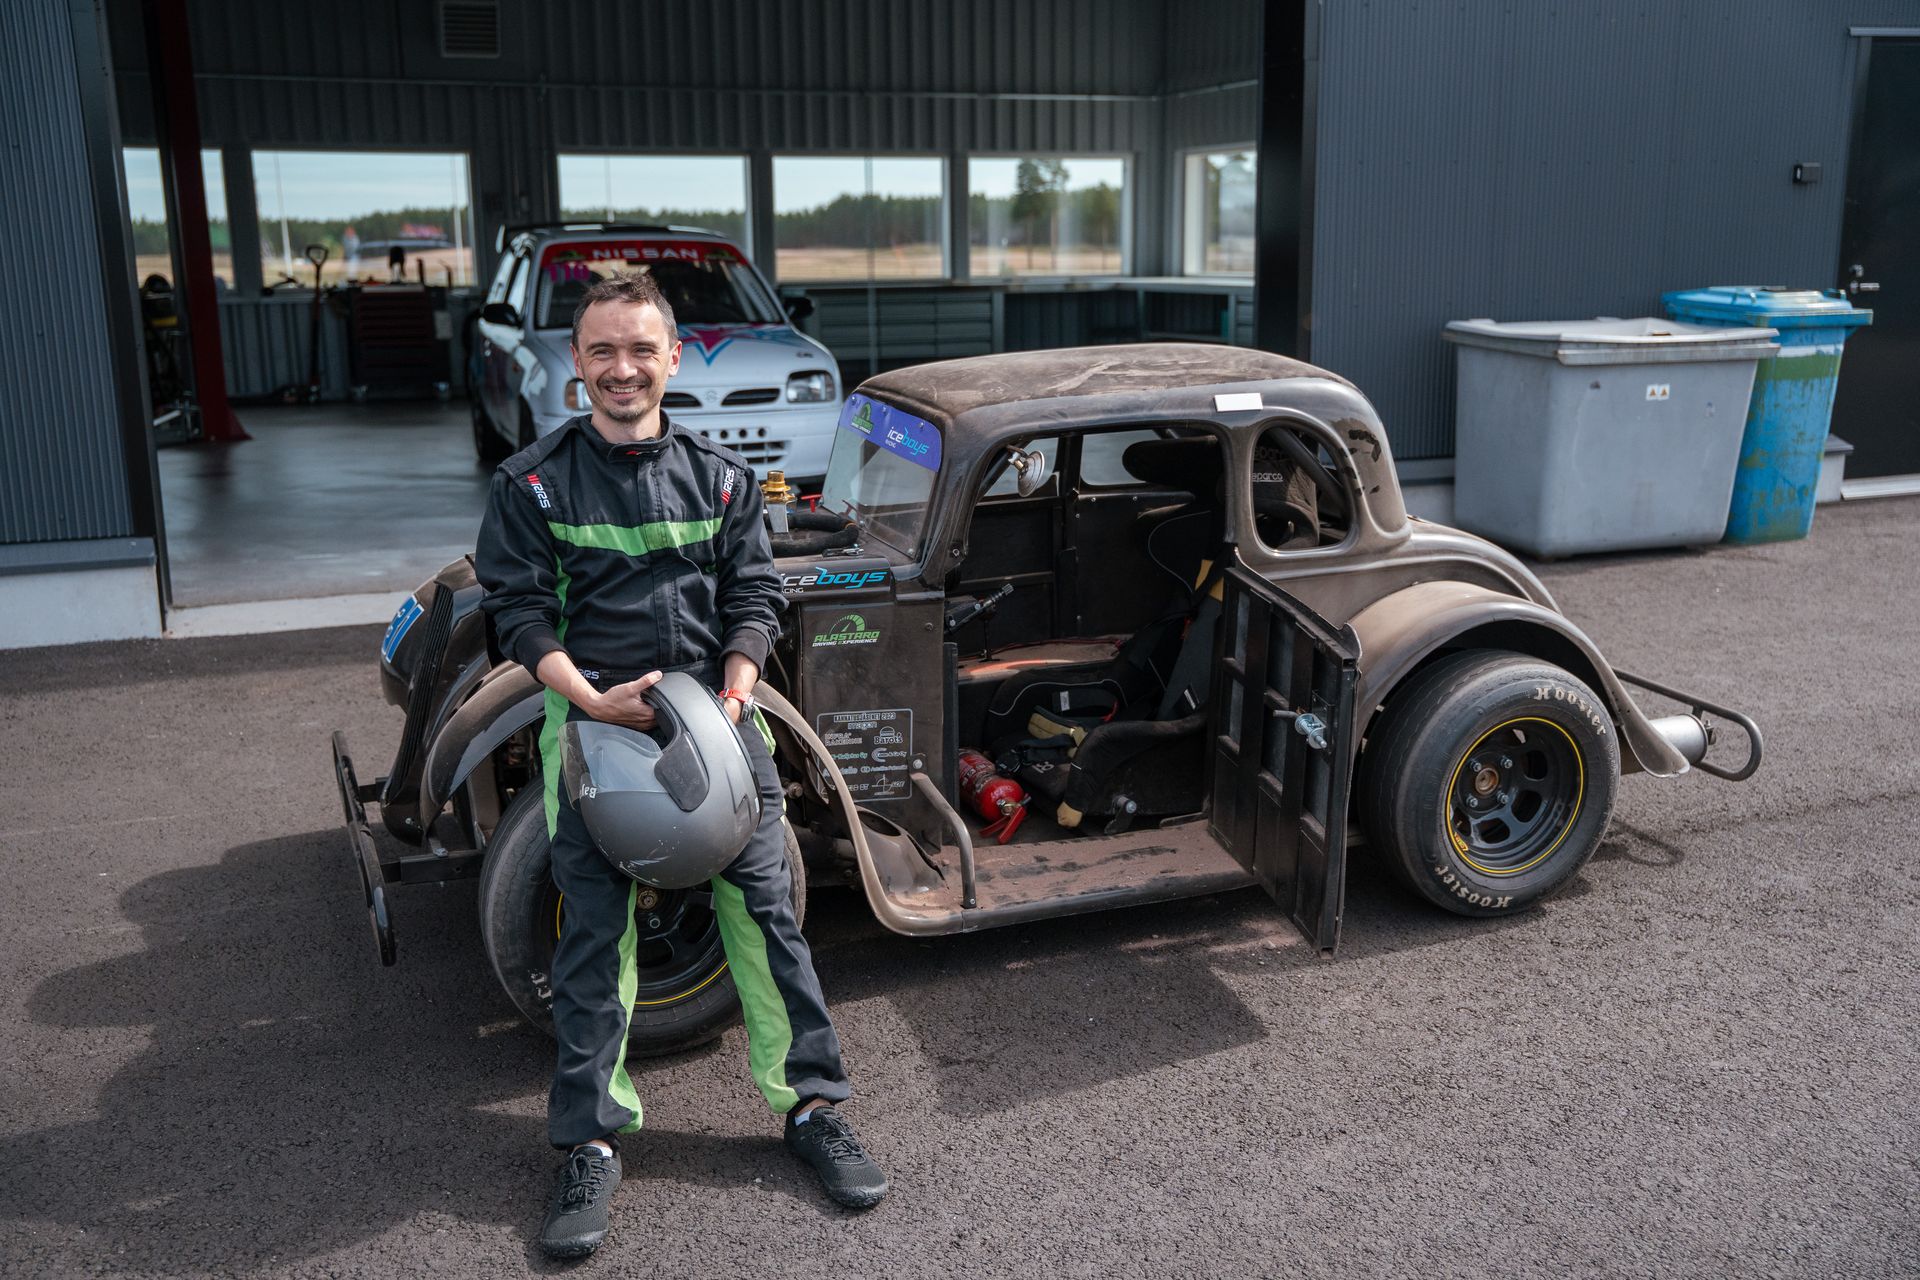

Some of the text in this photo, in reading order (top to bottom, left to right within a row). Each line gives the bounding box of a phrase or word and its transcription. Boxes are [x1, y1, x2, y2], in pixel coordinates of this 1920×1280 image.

[592, 248, 699, 259] NISSAN
[887, 426, 930, 456] iceboys
[814, 631, 881, 643] ALASTARO
[838, 638, 878, 646] EXPERIENCE
[1533, 686, 1607, 736] Hoosier
[1434, 863, 1514, 908] Hoosier
